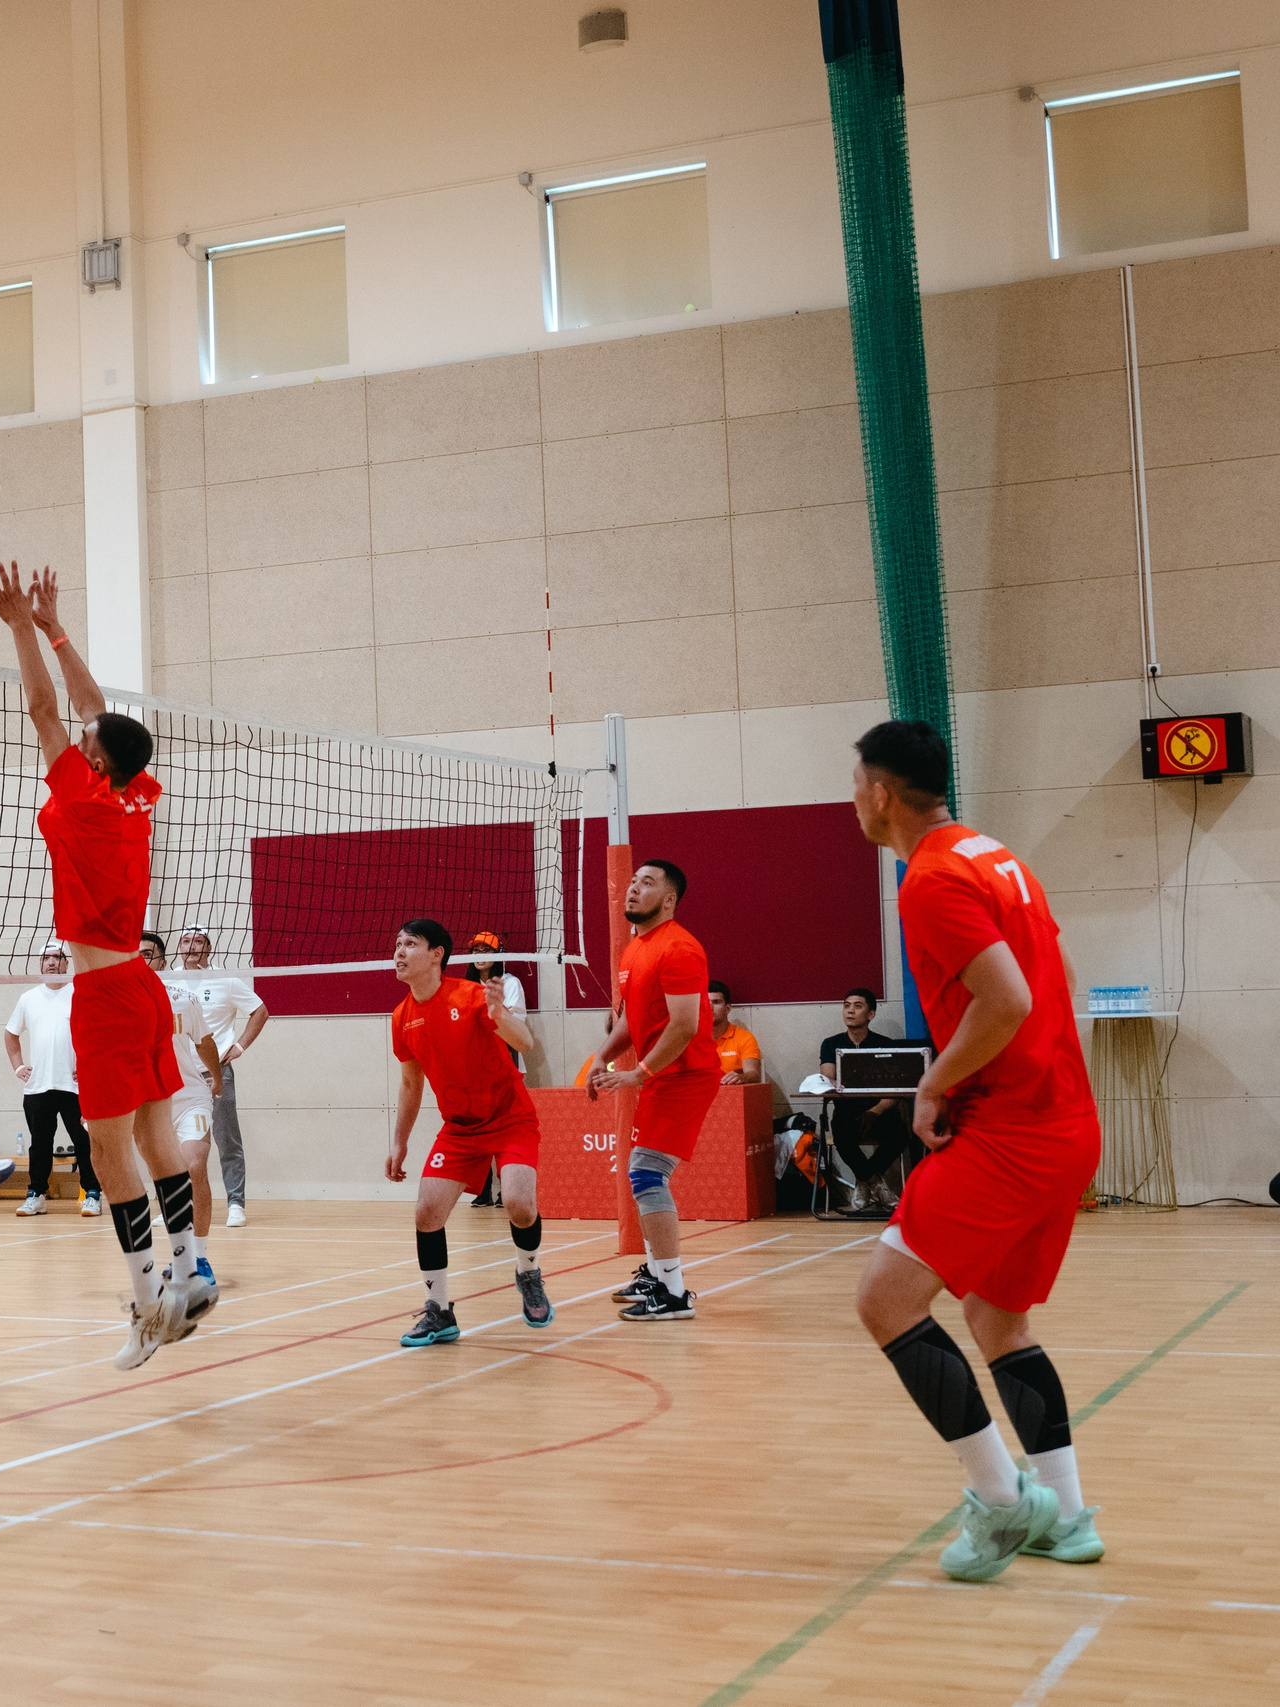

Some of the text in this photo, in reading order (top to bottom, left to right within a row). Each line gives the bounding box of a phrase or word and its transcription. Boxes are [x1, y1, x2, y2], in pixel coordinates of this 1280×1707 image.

[450, 1008, 460, 1021] 8
[194, 1114, 208, 1132] 11
[430, 1152, 445, 1168] 8
